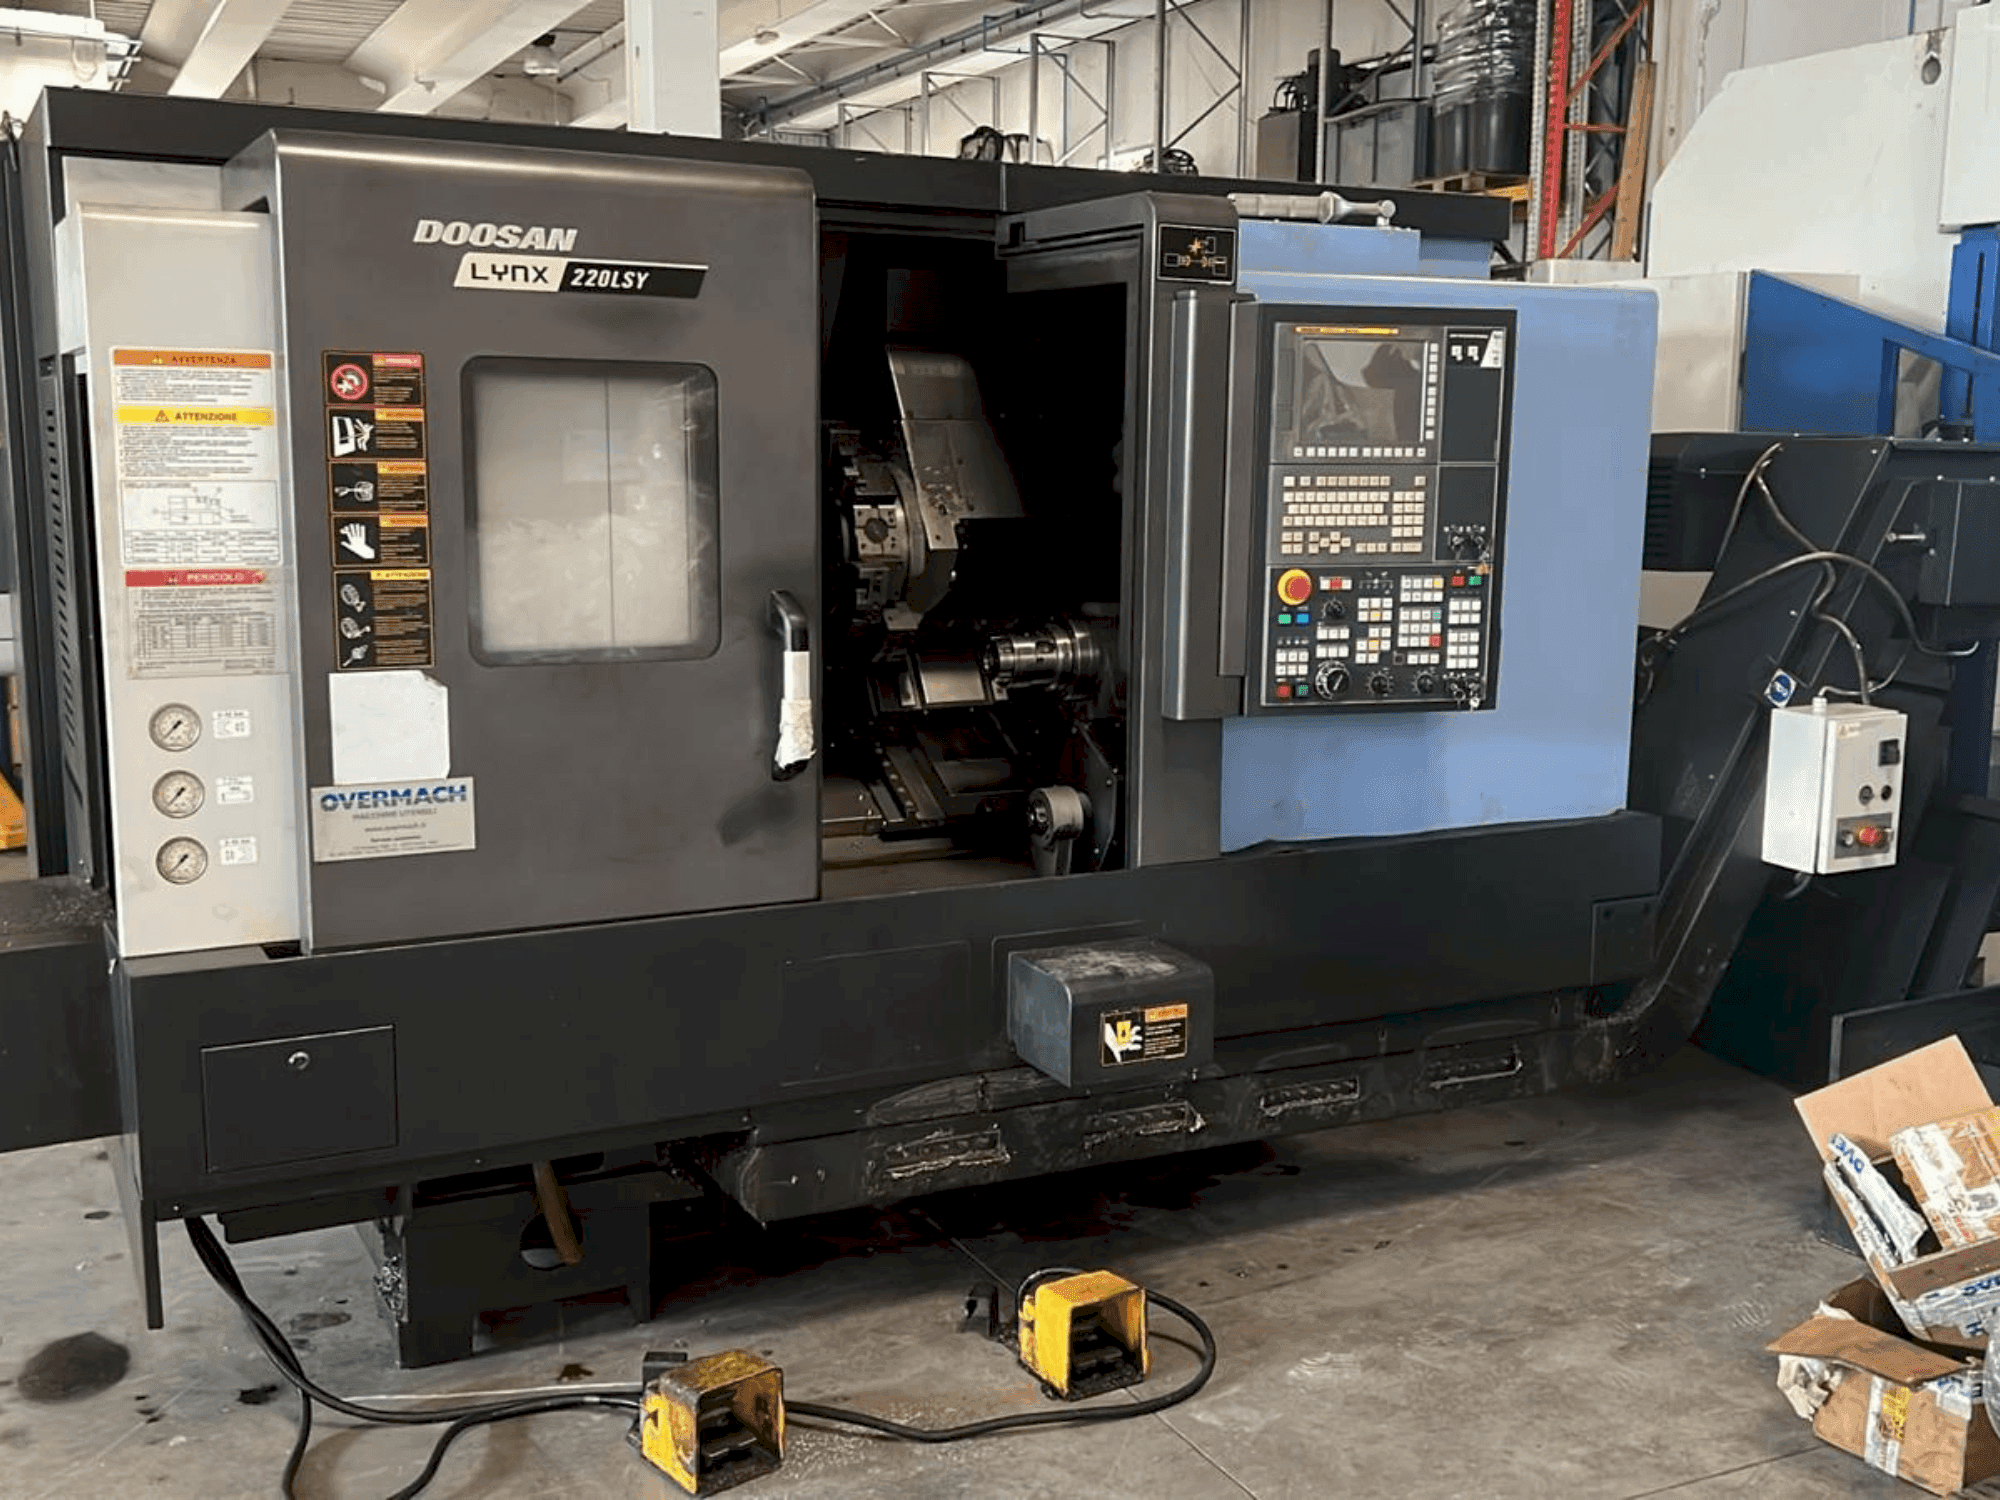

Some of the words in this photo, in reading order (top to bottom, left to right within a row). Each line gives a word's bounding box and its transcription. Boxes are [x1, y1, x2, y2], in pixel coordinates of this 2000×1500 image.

[413, 219, 578, 252] DOOSAN
[571, 268, 651, 291] 220LSY
[175, 412, 238, 422] ATTENZIONE
[320, 784, 467, 812] OVERMACH
